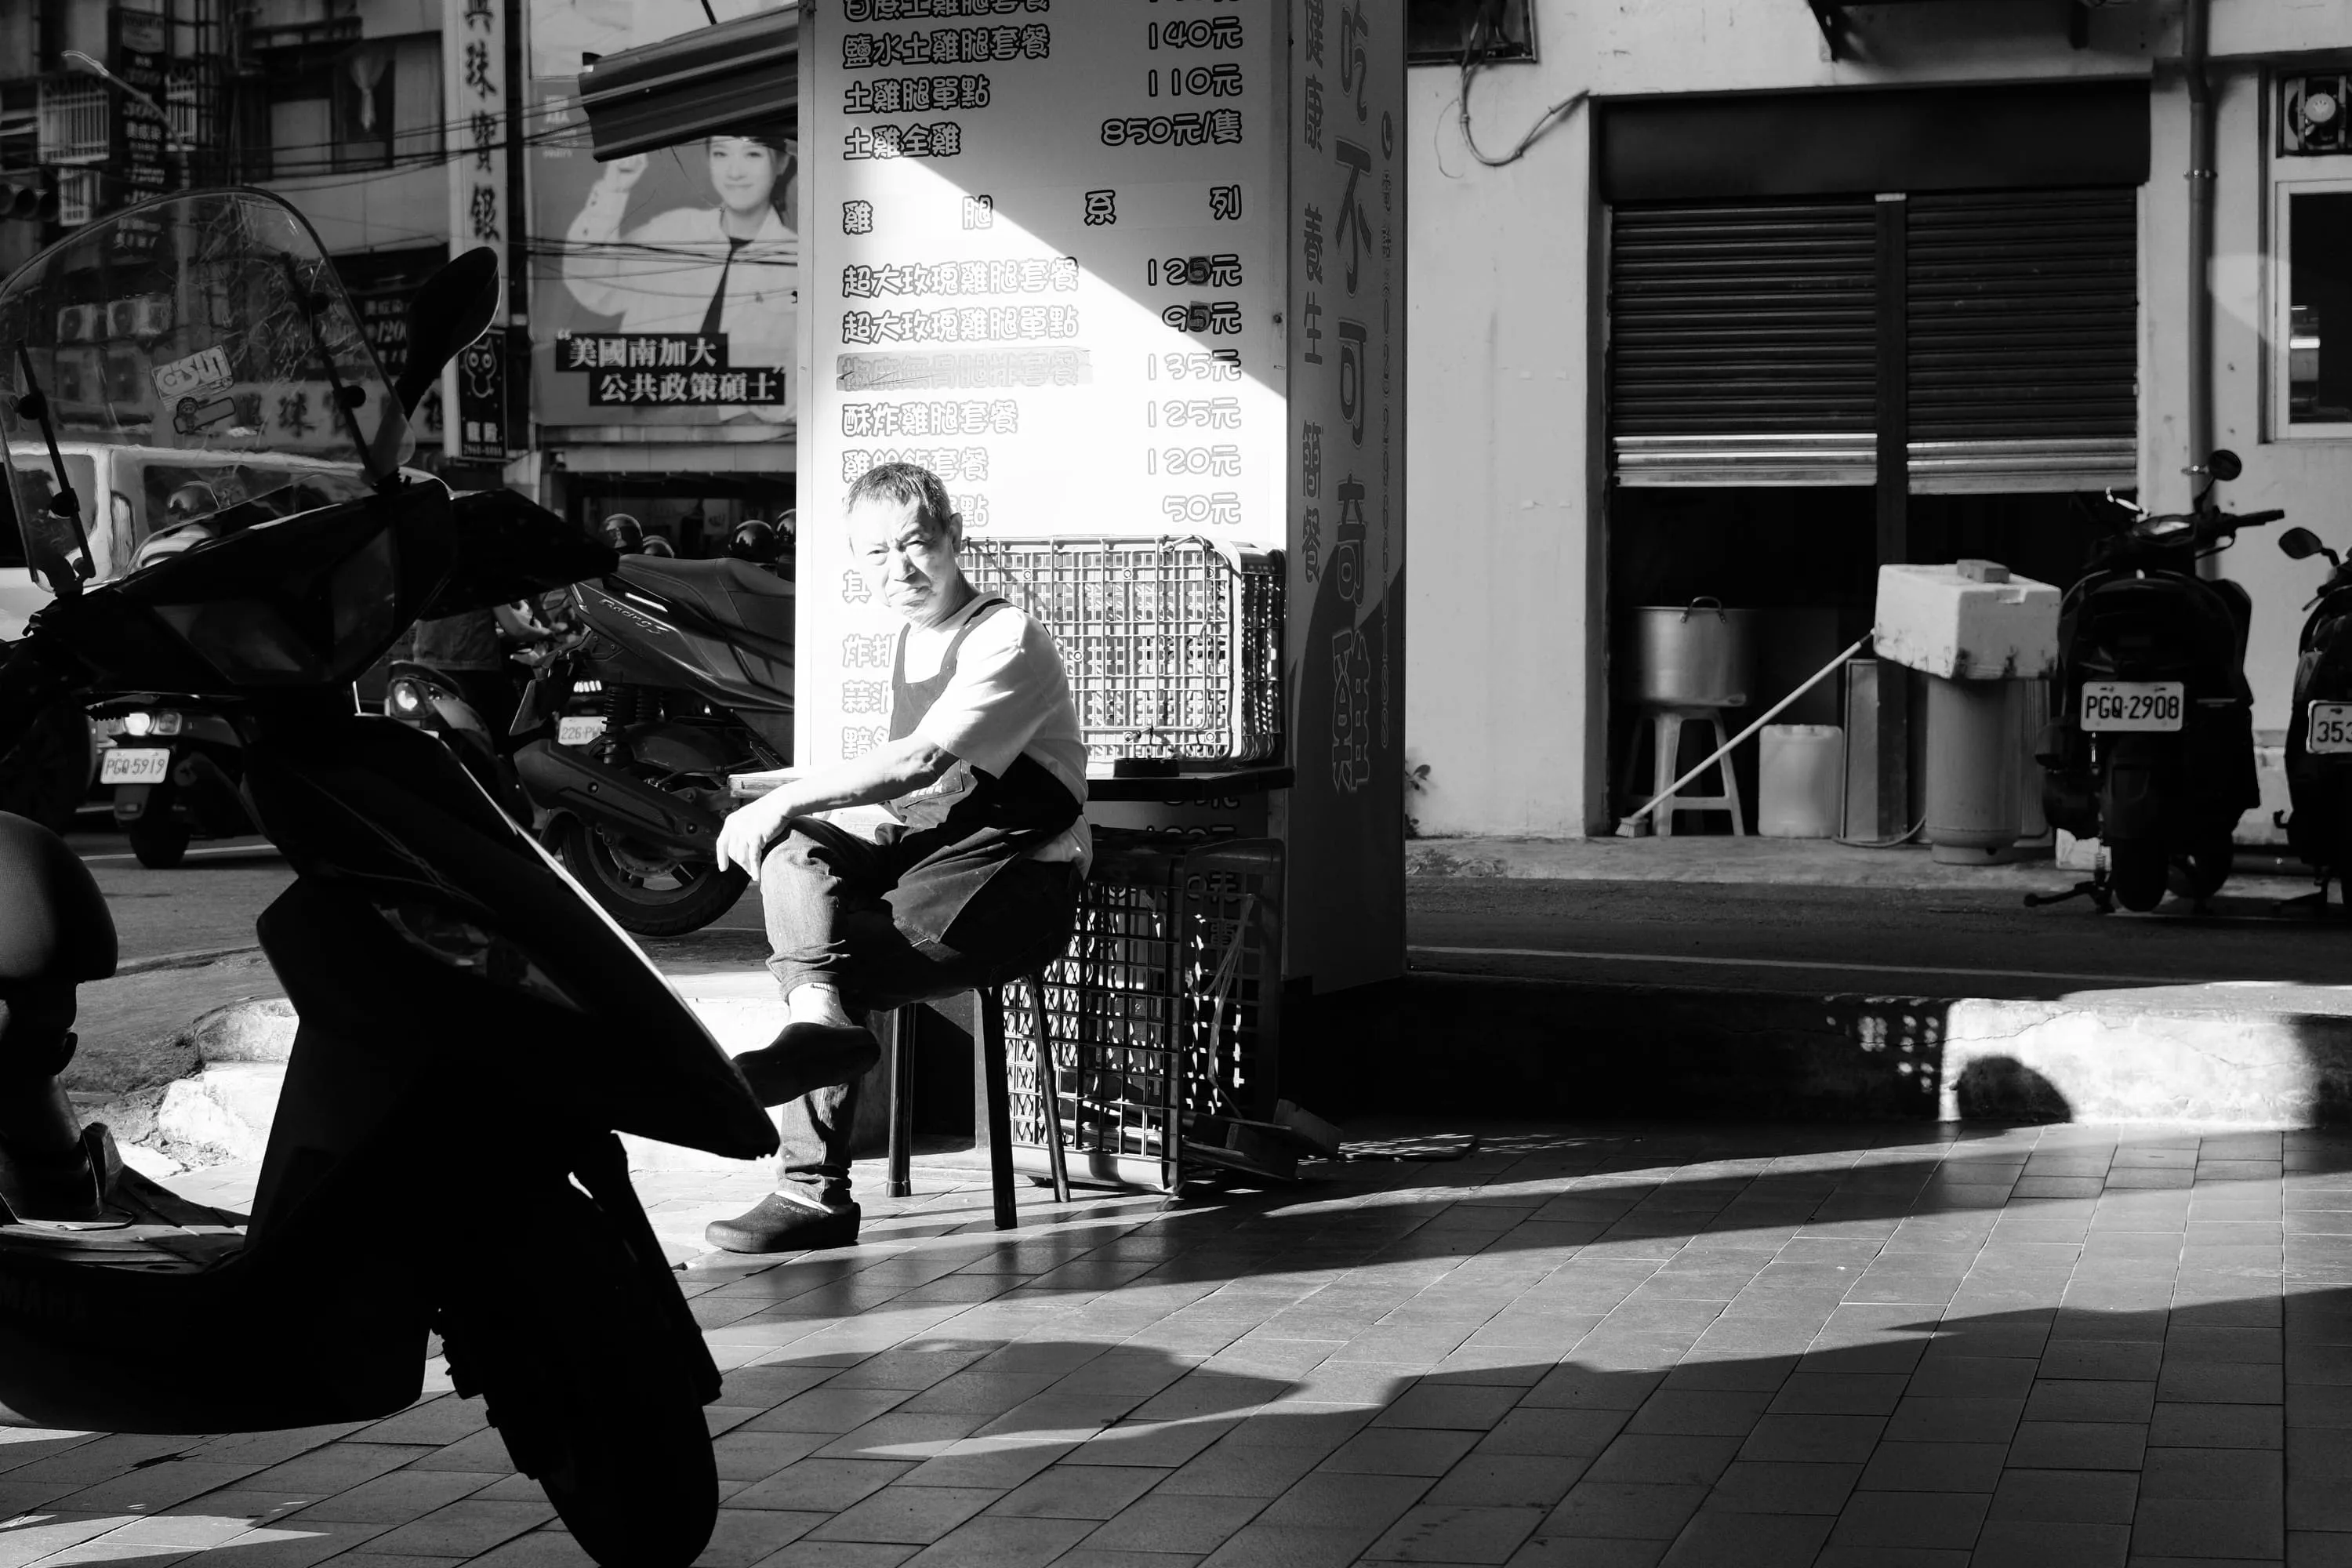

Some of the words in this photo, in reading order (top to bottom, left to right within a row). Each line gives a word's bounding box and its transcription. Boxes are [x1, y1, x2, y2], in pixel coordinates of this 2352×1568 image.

[843, 24, 1050, 69] 鹽水土雞腿套餐
[1149, 16, 1243, 50] 140元
[844, 74, 990, 114] 土雞腿單點
[1148, 64, 1243, 97] 110元
[844, 122, 961, 161] 土雞全雞
[1101, 108, 1243, 147] 850元/隻
[842, 256, 1080, 299] 超大玫瑰雞腿套餐
[1147, 252, 1243, 287] 125元
[842, 303, 1080, 345] 超大玫瑰雞腿單點
[1162, 300, 1243, 335] 95元
[1147, 350, 1243, 383] 135元
[841, 400, 1019, 437] 酥炸雞腿套餐
[1147, 396, 1243, 430] 125元
[1147, 444, 1243, 477] 120元
[1162, 492, 1243, 524] 50元
[2085, 695, 2180, 720] PGQ-2908
